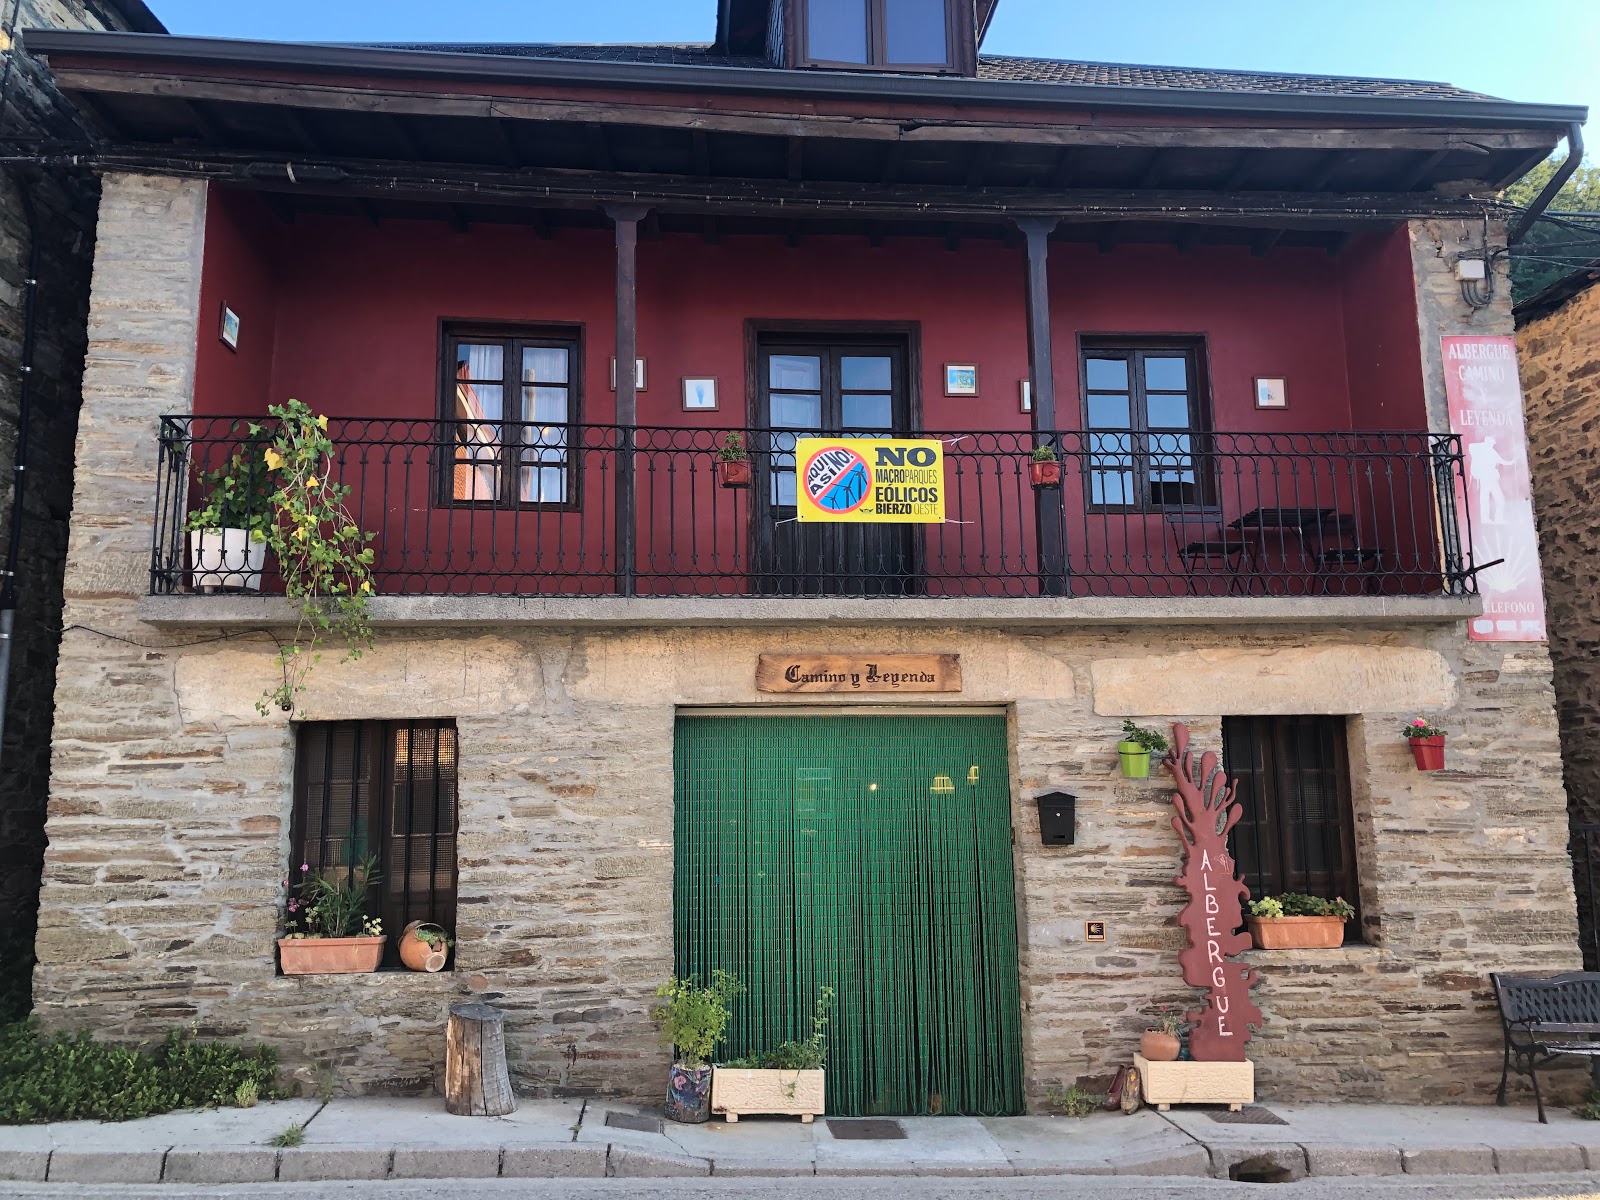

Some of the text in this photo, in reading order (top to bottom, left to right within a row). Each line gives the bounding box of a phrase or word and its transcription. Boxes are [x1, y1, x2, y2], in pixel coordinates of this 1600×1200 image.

[1448, 343, 1510, 360] ALBERGUE
[1458, 365, 1505, 382] CAMINO
[1459, 409, 1513, 426] LEYENDA
[874, 447, 937, 467] NO
[875, 468, 938, 484] MACROPARQUES
[875, 483, 939, 503] EÓLICOS
[875, 503, 939, 515] BIERZO OESTE
[1482, 601, 1535, 613] ELEFONO
[784, 663, 936, 689] Camino y Leyenda
[1200, 849, 1234, 1037] ALBERGUE
